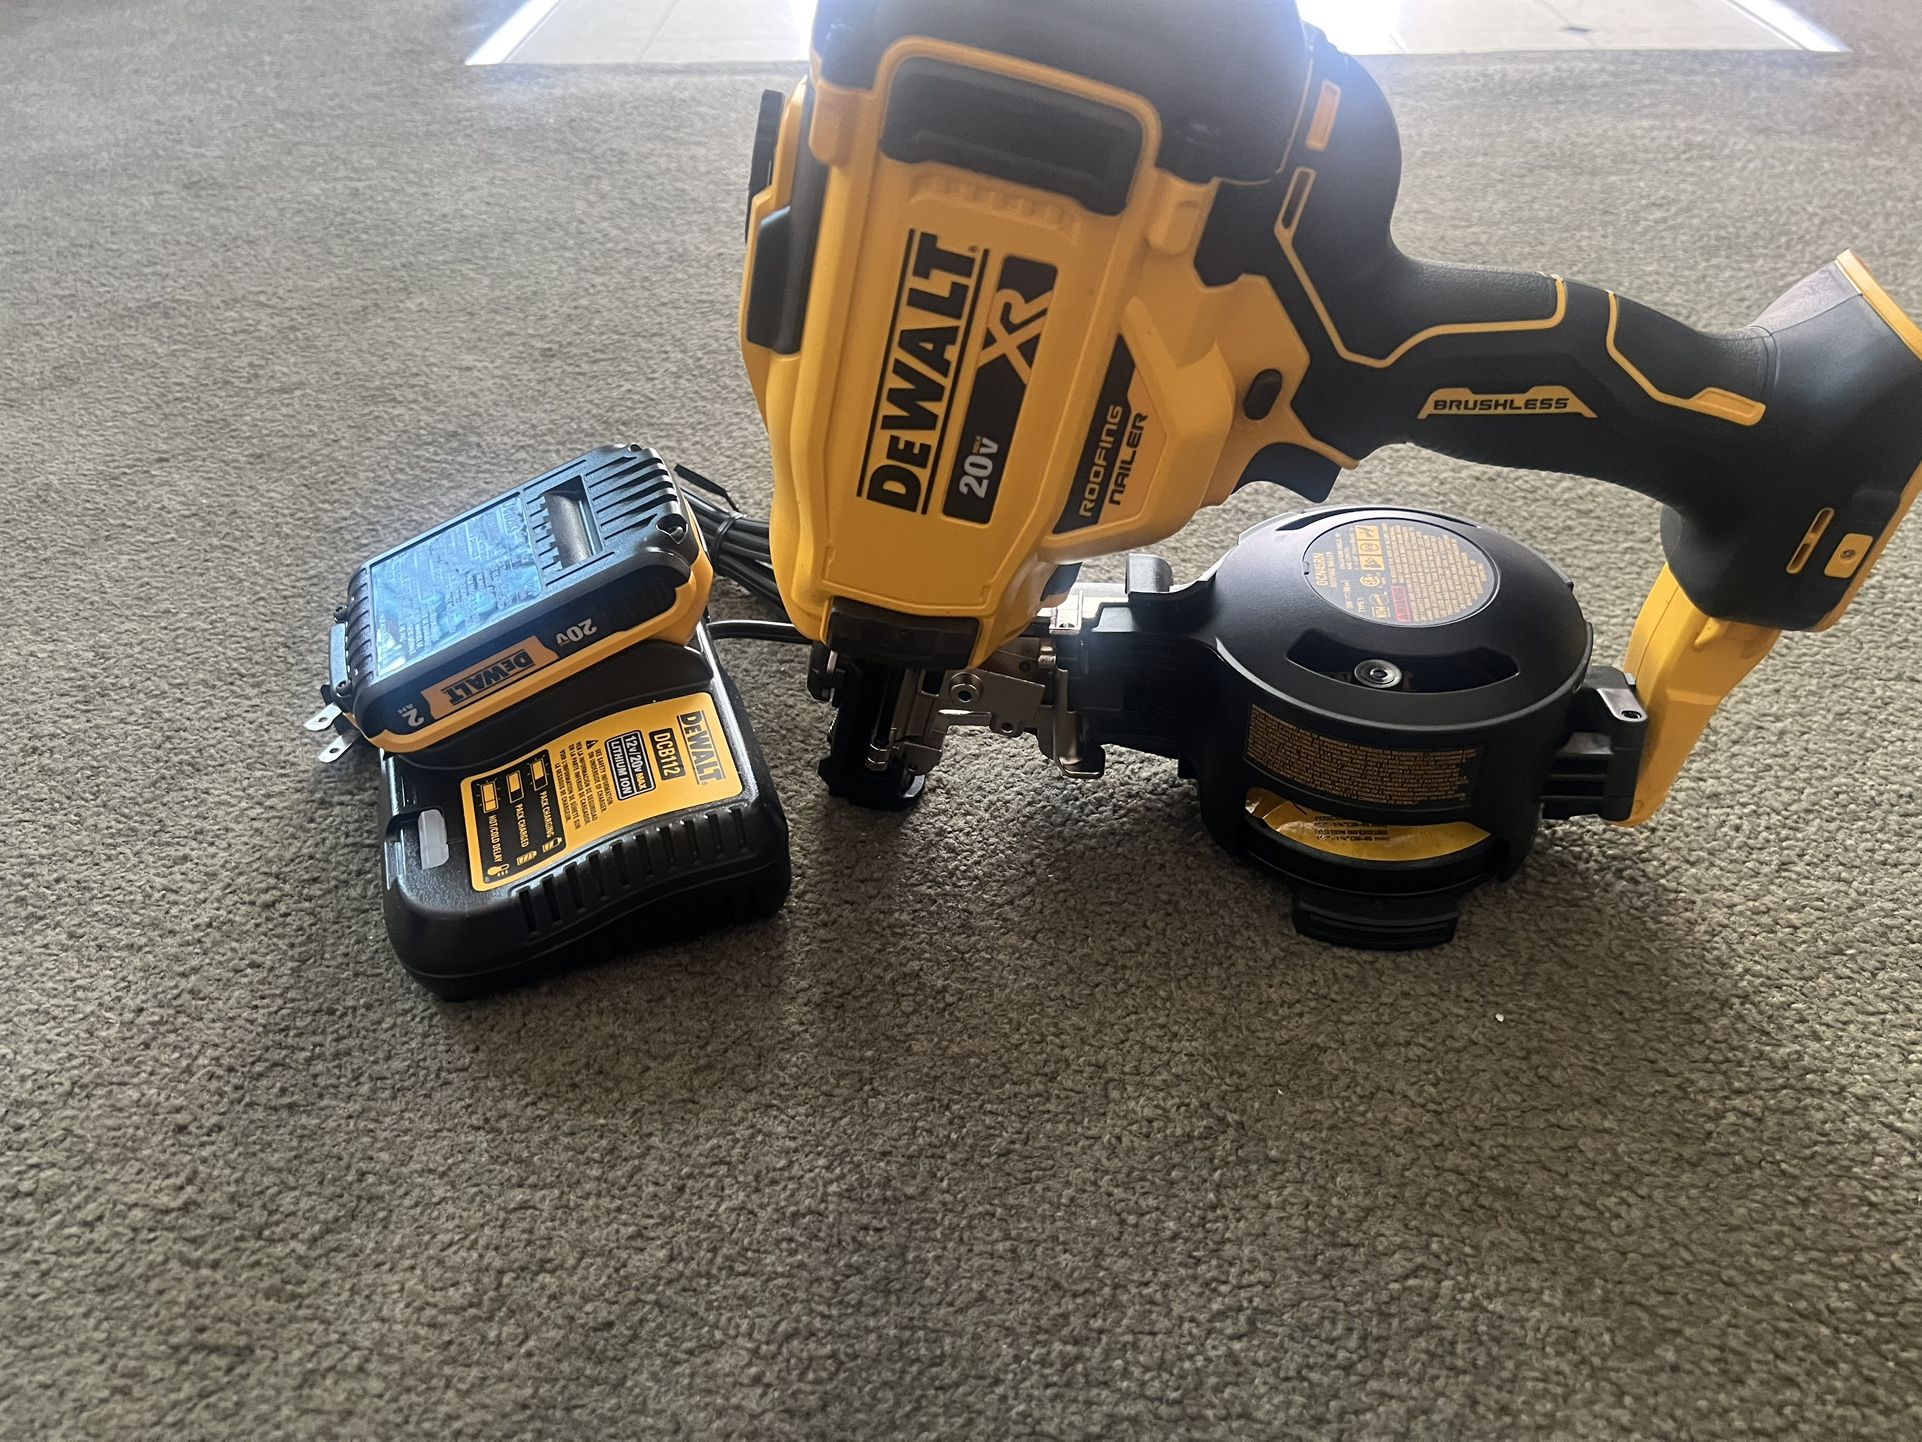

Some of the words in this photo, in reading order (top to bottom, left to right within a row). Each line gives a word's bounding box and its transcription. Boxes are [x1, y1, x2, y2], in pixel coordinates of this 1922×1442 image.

[975, 285, 1053, 384] XR
[865, 230, 979, 512] DEWALT
[1433, 397, 1569, 410] BRUSHLESS
[1078, 403, 1123, 516] ROOFING
[1107, 412, 1148, 505] NAILER
[443, 651, 533, 704] DEWALT
[401, 706, 425, 726] 2
[653, 731, 681, 776] DCB112
[679, 710, 722, 783] DEWALT
[610, 740, 627, 776] LITHIUM
[619, 776, 632, 794] ION
[634, 772, 647, 790] MAX
[538, 790, 549, 807] PACK
[600, 773, 613, 805] INFORMATION
[514, 802, 524, 818] PACK
[541, 805, 554, 838] CHARGING
[487, 814, 500, 844] HOT/COLD
[517, 818, 529, 848] CHARGED
[491, 843, 502, 862] DELAY
